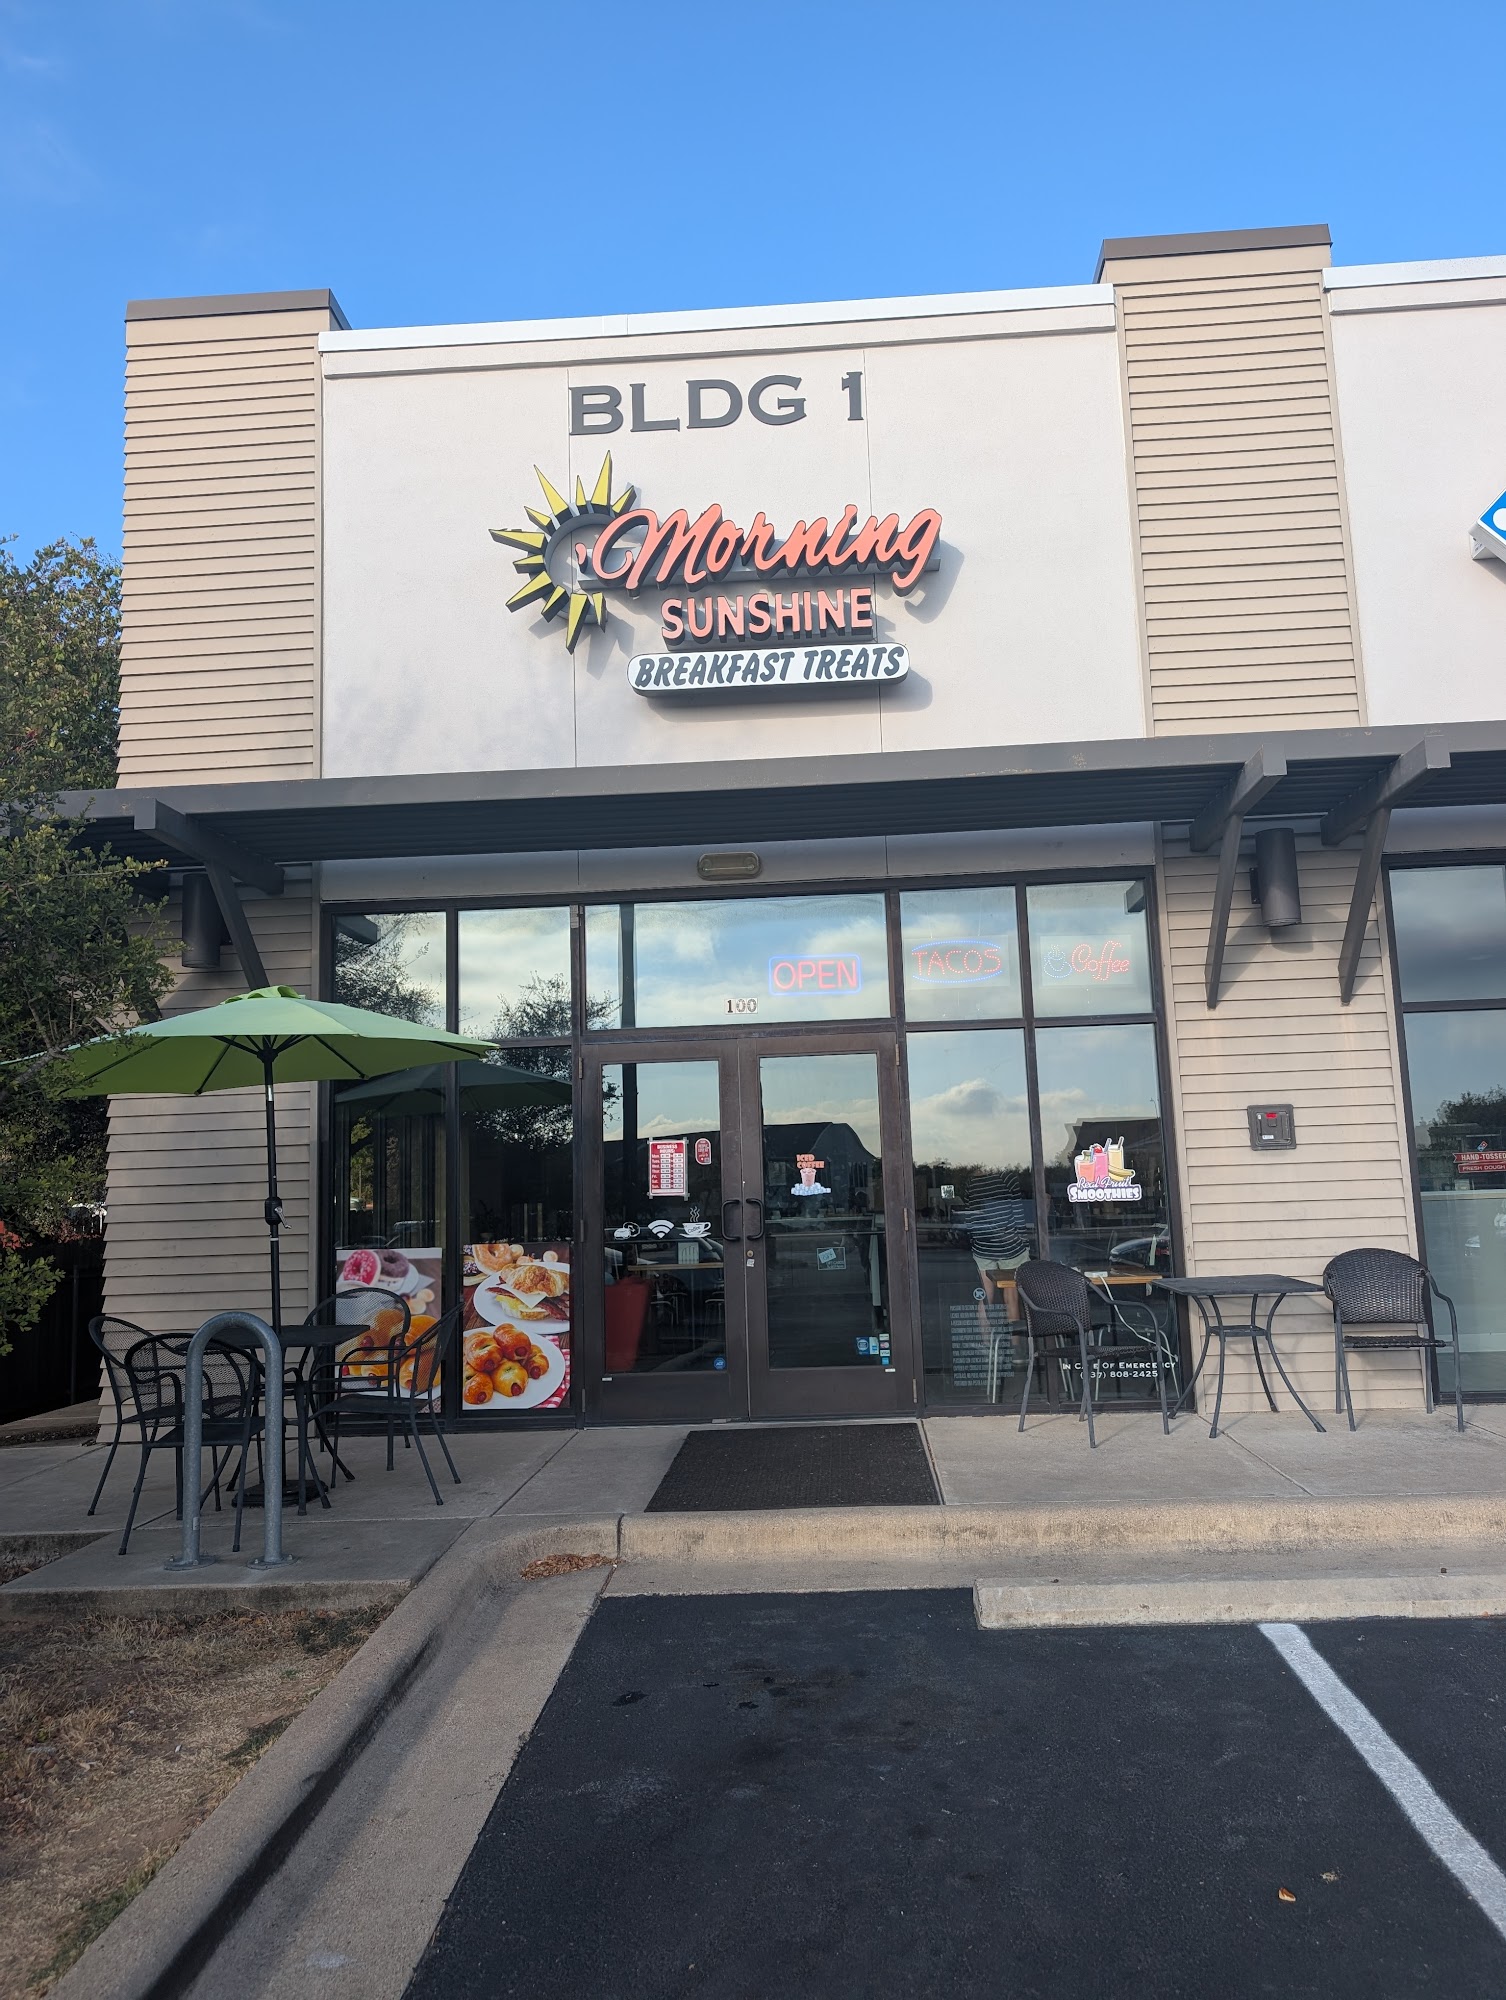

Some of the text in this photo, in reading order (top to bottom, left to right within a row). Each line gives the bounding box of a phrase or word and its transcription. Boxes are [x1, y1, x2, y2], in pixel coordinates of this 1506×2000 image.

[569, 371, 864, 436] BLDG 1
[592, 503, 943, 589] Morning
[661, 588, 874, 640] SUNSHINE
[633, 645, 905, 688] BREAKFAST TREATS
[772, 959, 859, 990] OPEN
[911, 948, 1002, 977] TACOS
[1071, 941, 1131, 981] Coffee
[726, 998, 757, 1014] 100
[1070, 1187, 1139, 1200] SMOOTHIES
[1078, 1176, 1130, 1189] Real Fruit
[1080, 1370, 1158, 1379] (37) 808-2425
